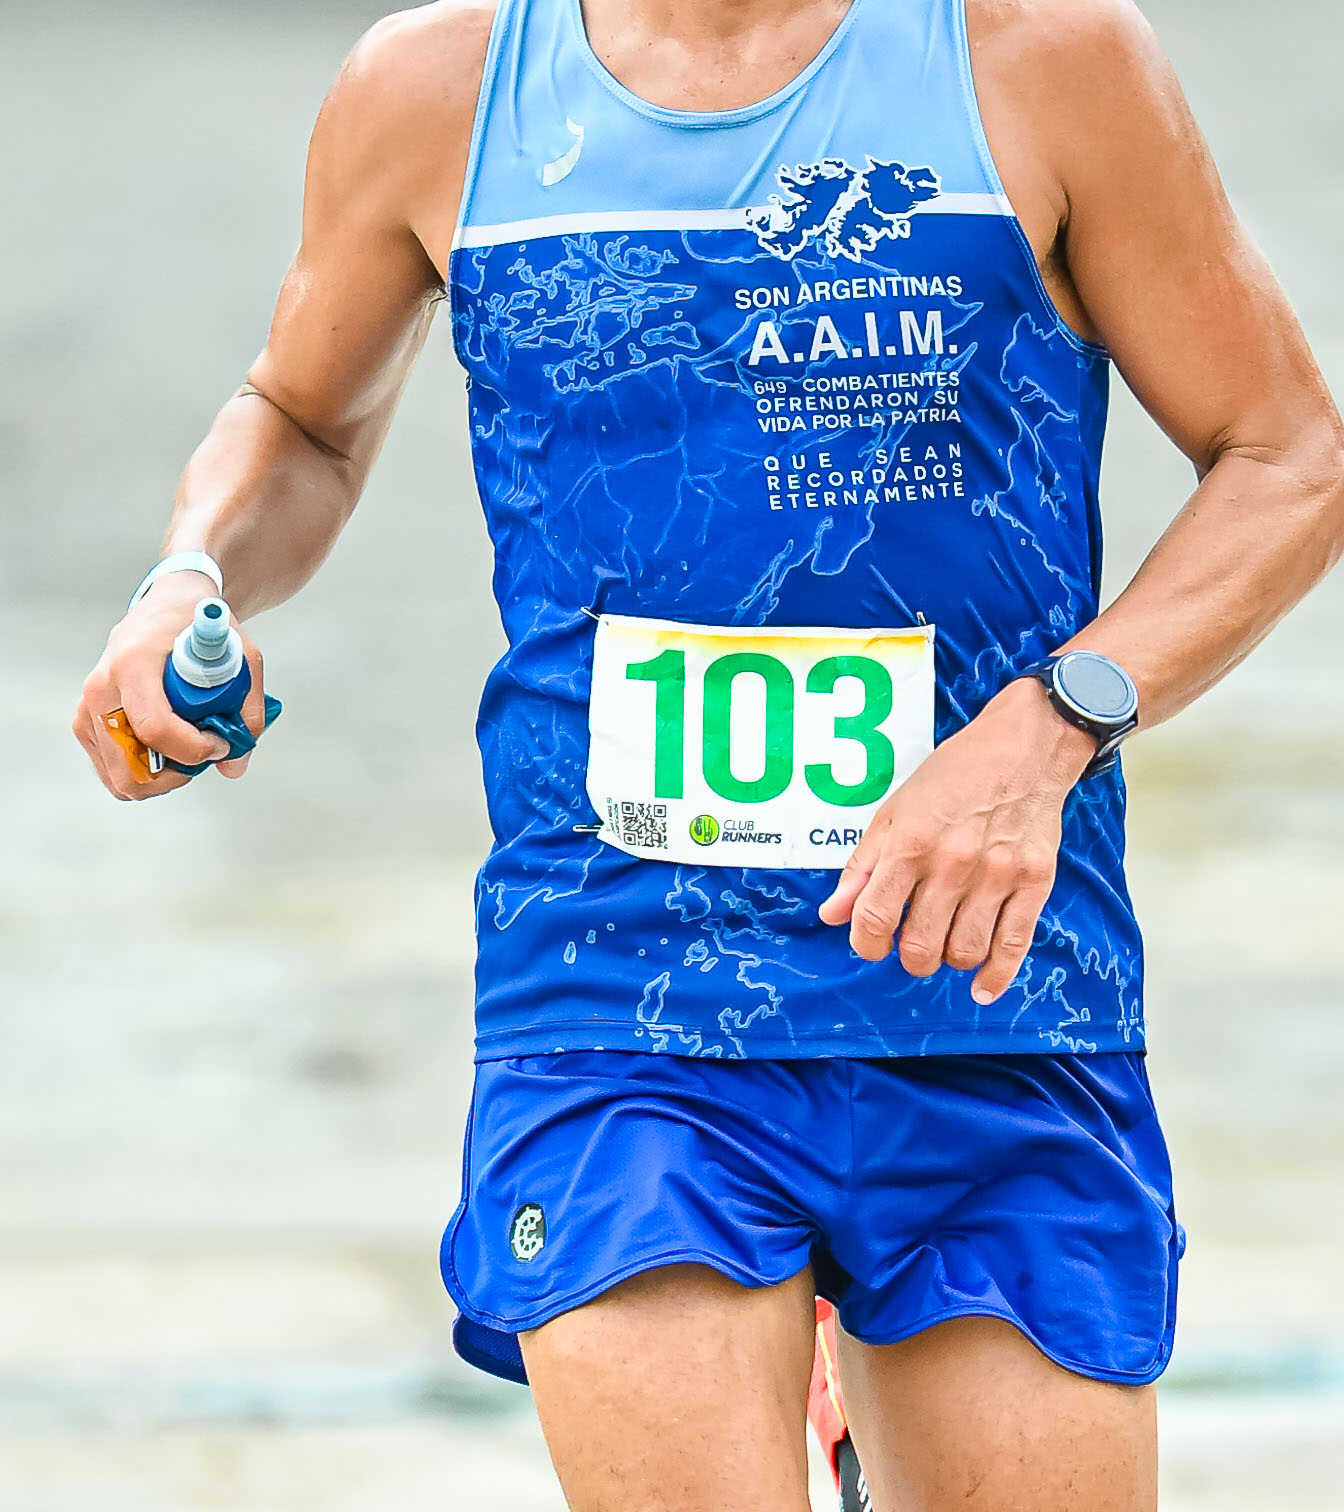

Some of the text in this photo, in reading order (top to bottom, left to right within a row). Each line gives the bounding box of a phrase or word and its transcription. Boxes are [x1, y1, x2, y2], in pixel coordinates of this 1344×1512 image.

[734, 275, 963, 310] SON ARGENTINAS
[748, 310, 958, 366] A.A.I.M.
[754, 371, 960, 395] 649 COMBATIENTES
[756, 390, 959, 414] OFRENDARON SU
[757, 408, 962, 433] VIDA POR LA PATRIA
[763, 442, 962, 472] QUE SEAN
[766, 462, 964, 491] RECORDADOS
[769, 481, 965, 511] ETERNAMENTE
[625, 649, 895, 807] 103
[721, 831, 782, 844] RUNNER'S
[723, 819, 754, 831] CLUB
